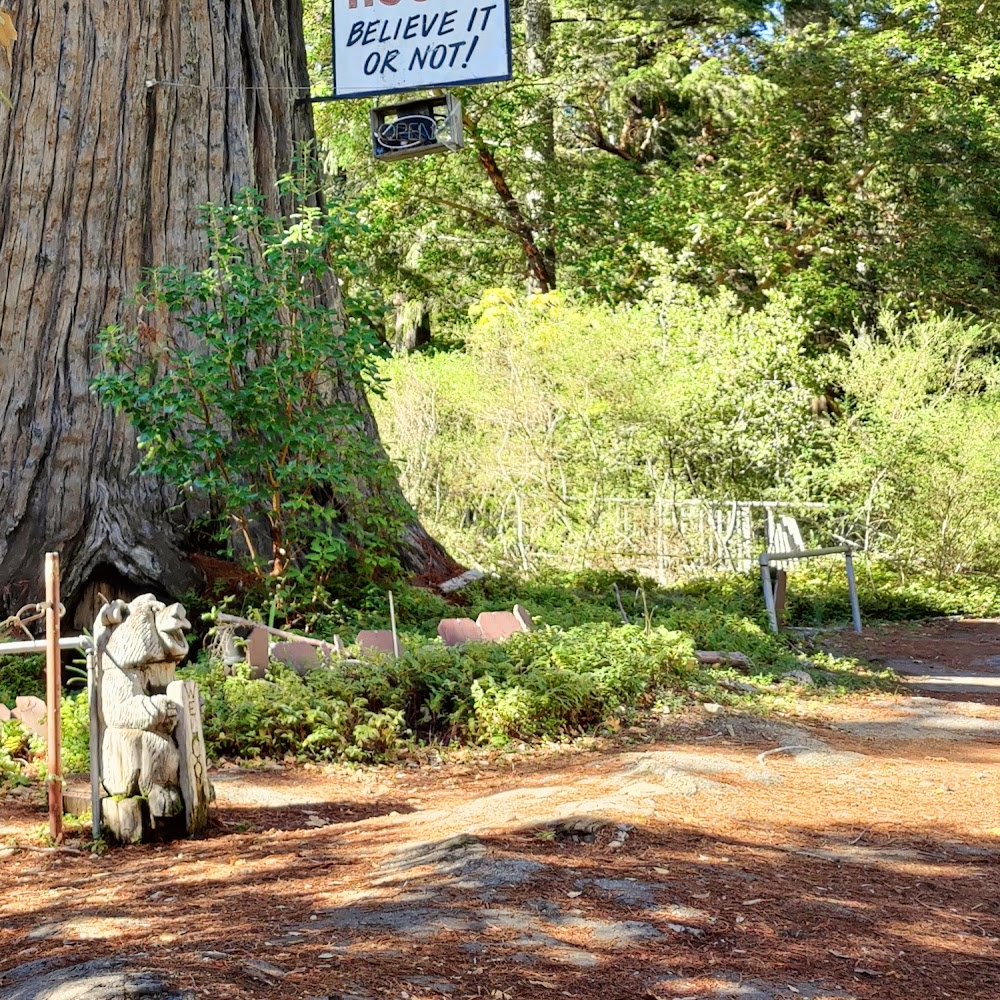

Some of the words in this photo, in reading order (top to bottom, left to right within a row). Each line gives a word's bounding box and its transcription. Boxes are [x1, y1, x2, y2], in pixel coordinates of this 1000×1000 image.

[346, 9, 458, 47] BELIEVE
[467, 4, 497, 32] IT
[363, 49, 399, 75] OR
[408, 35, 479, 71] NOT!
[377, 122, 437, 142] OPEN
